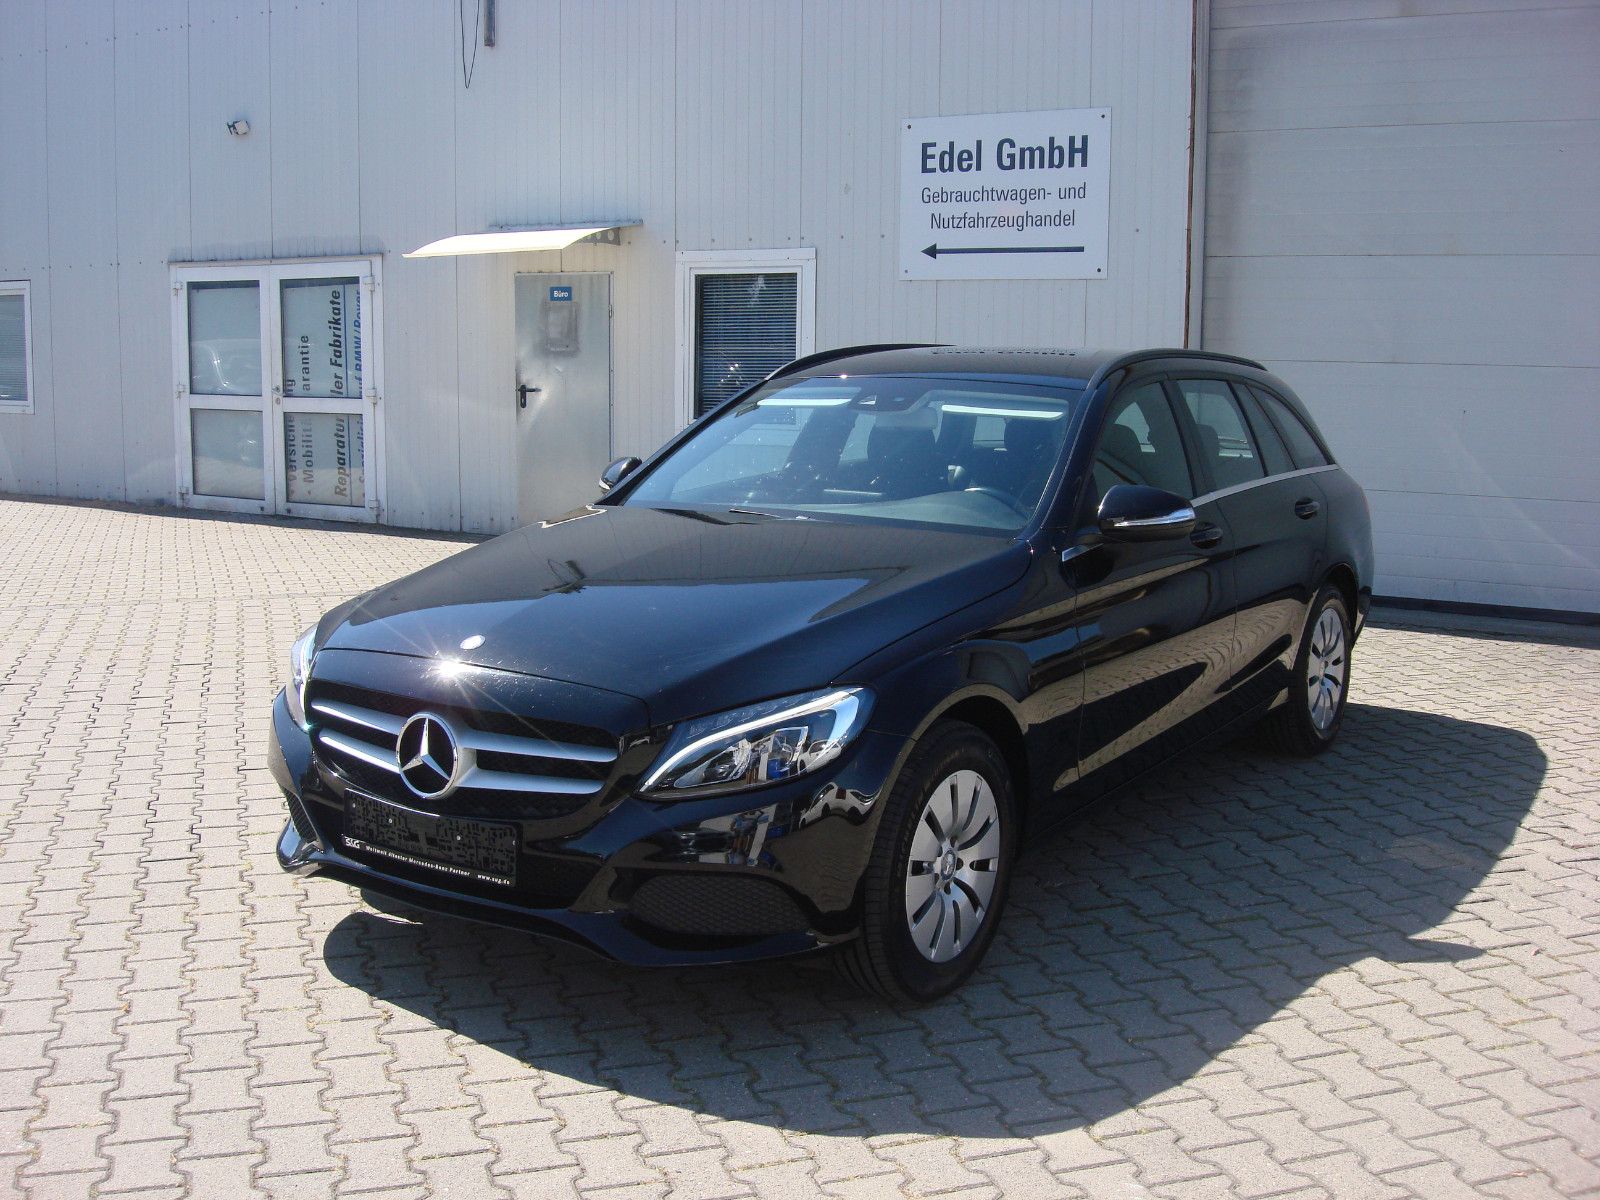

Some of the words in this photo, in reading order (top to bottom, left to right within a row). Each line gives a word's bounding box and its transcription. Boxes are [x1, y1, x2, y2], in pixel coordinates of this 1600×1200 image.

[921, 139, 983, 174] Edel
[996, 134, 1089, 171] GmbH
[921, 185, 1052, 205] Gebrauchtwagen-
[1058, 181, 1087, 200] und
[930, 209, 1076, 232] Nutzfahrzeughandel
[553, 290, 569, 298] Büro
[327, 289, 343, 367] Fabrikate
